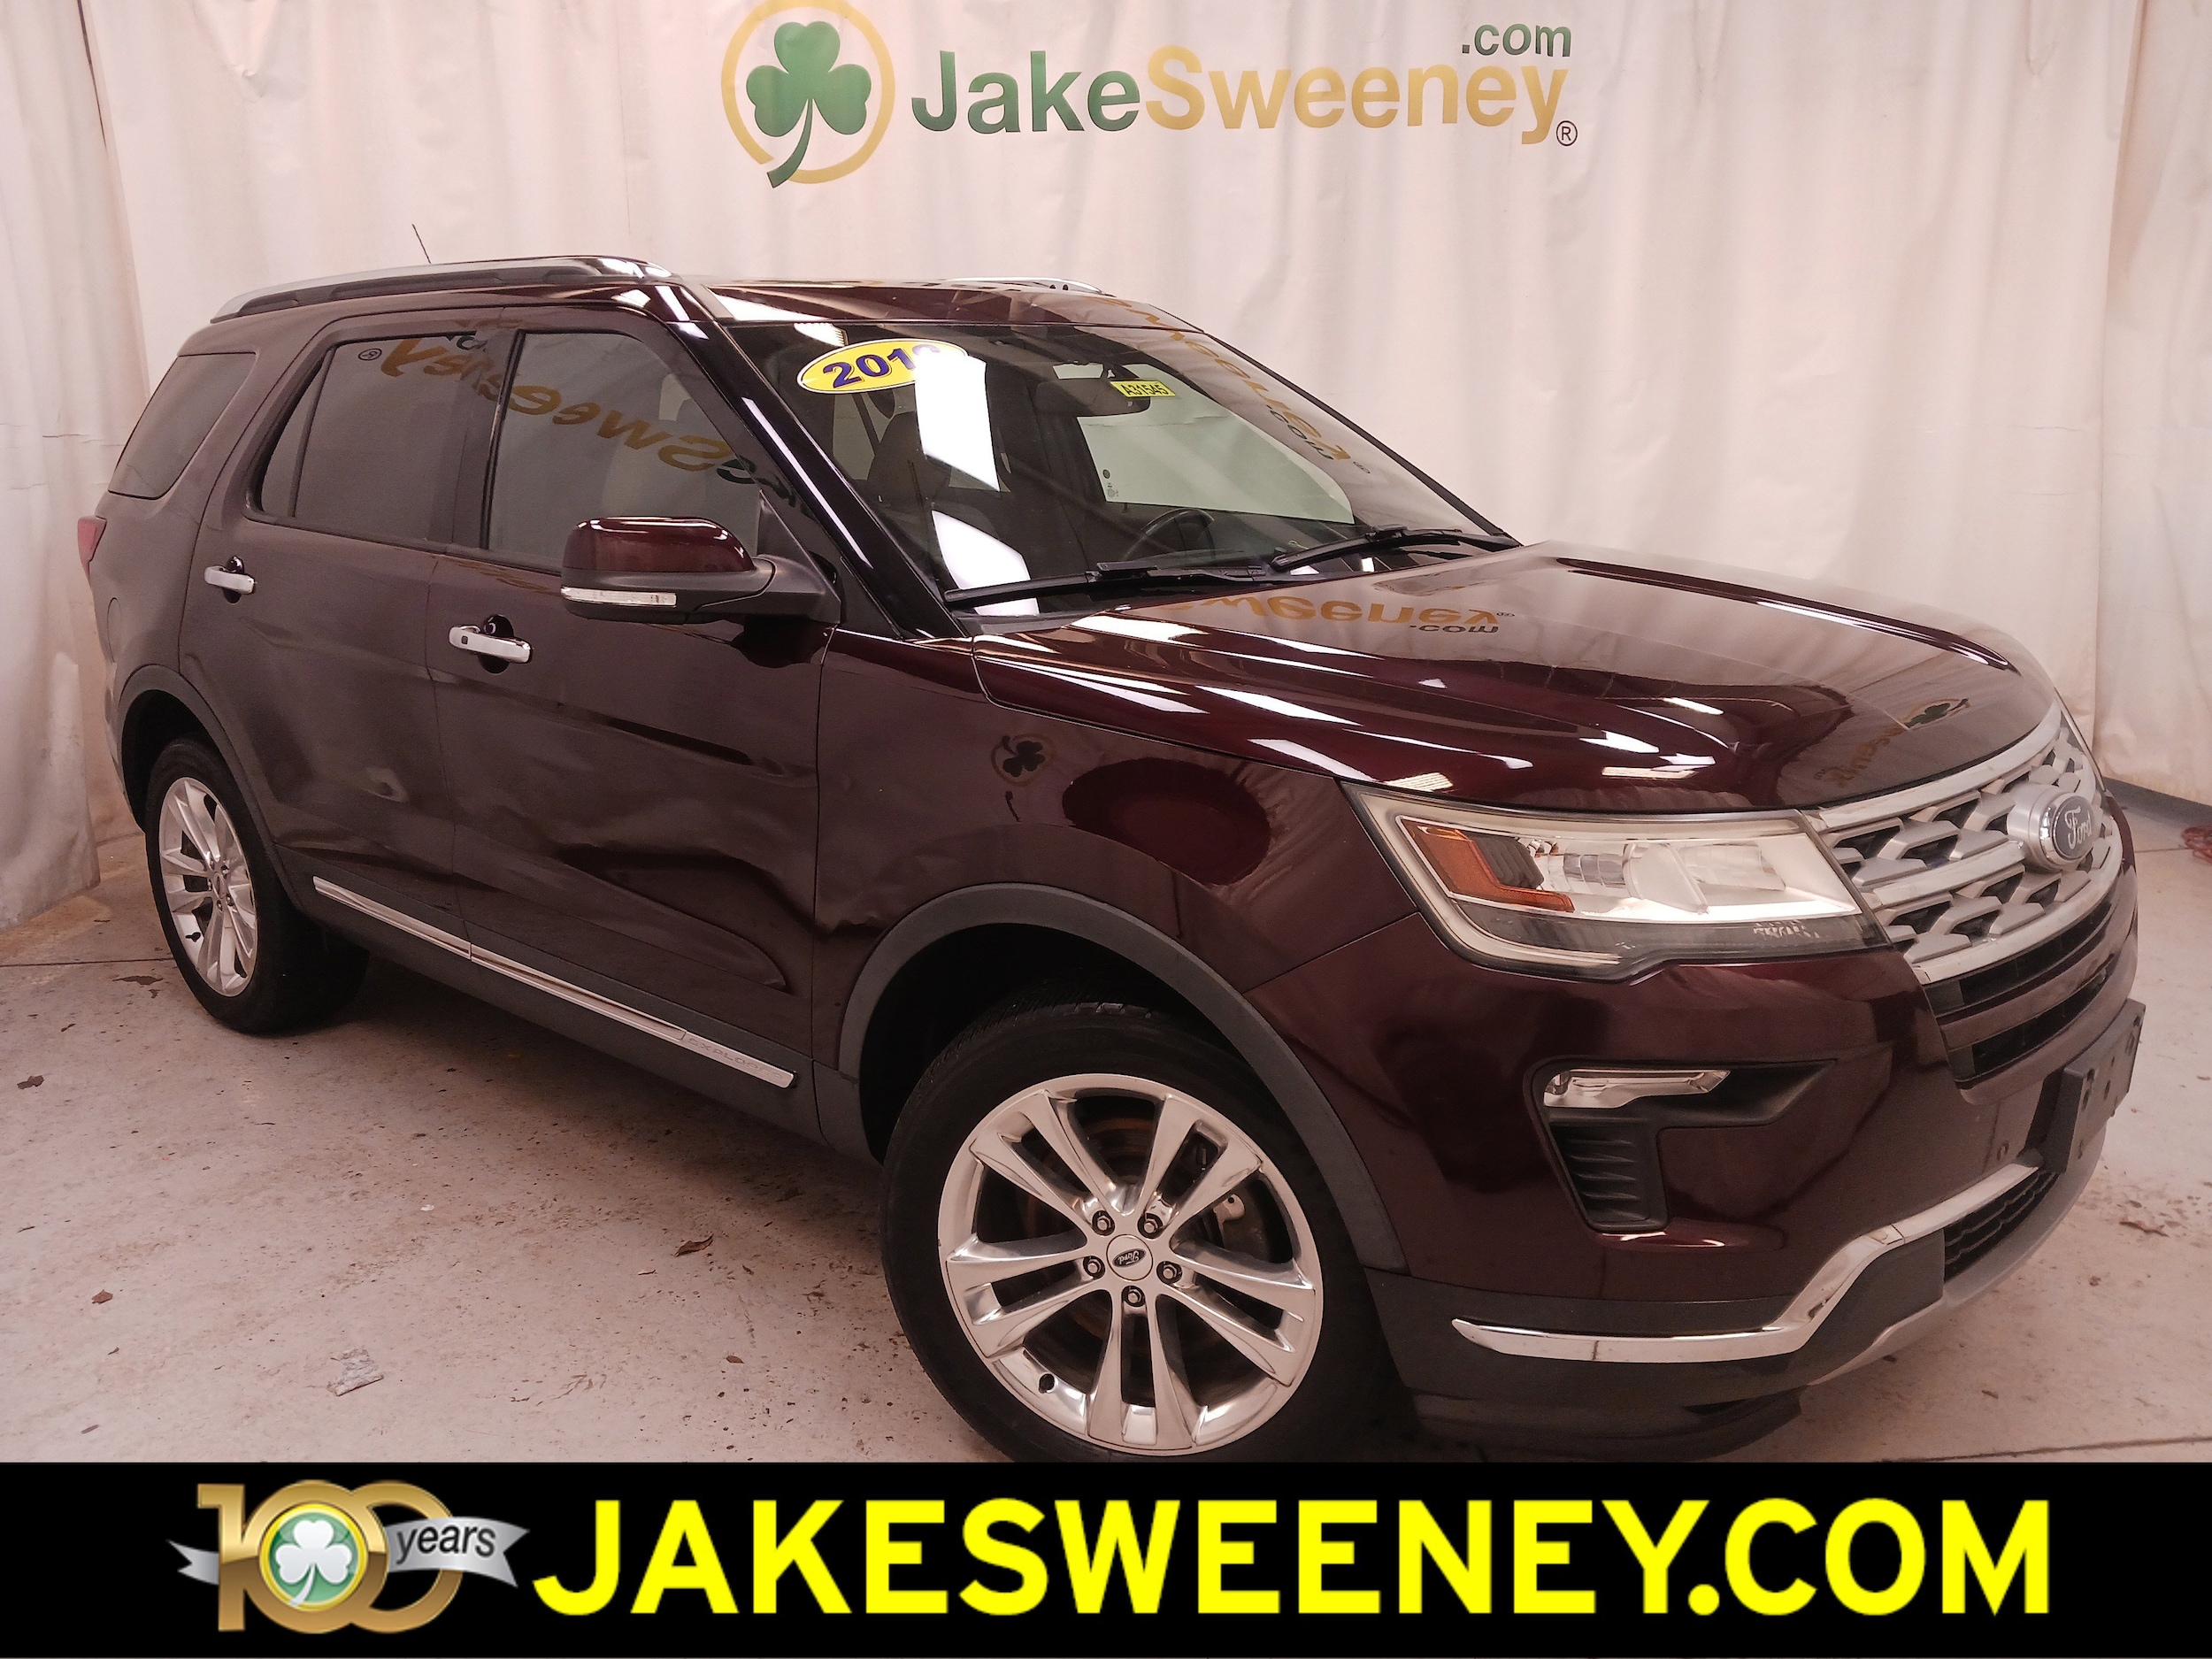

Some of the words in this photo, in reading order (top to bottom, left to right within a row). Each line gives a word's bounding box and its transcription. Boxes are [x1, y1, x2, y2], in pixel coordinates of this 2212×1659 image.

[1462, 24, 1571, 58] .com
[823, 343, 941, 388] 201
[1120, 384, 1169, 396] A31545
[2064, 805, 2093, 849] Ford
